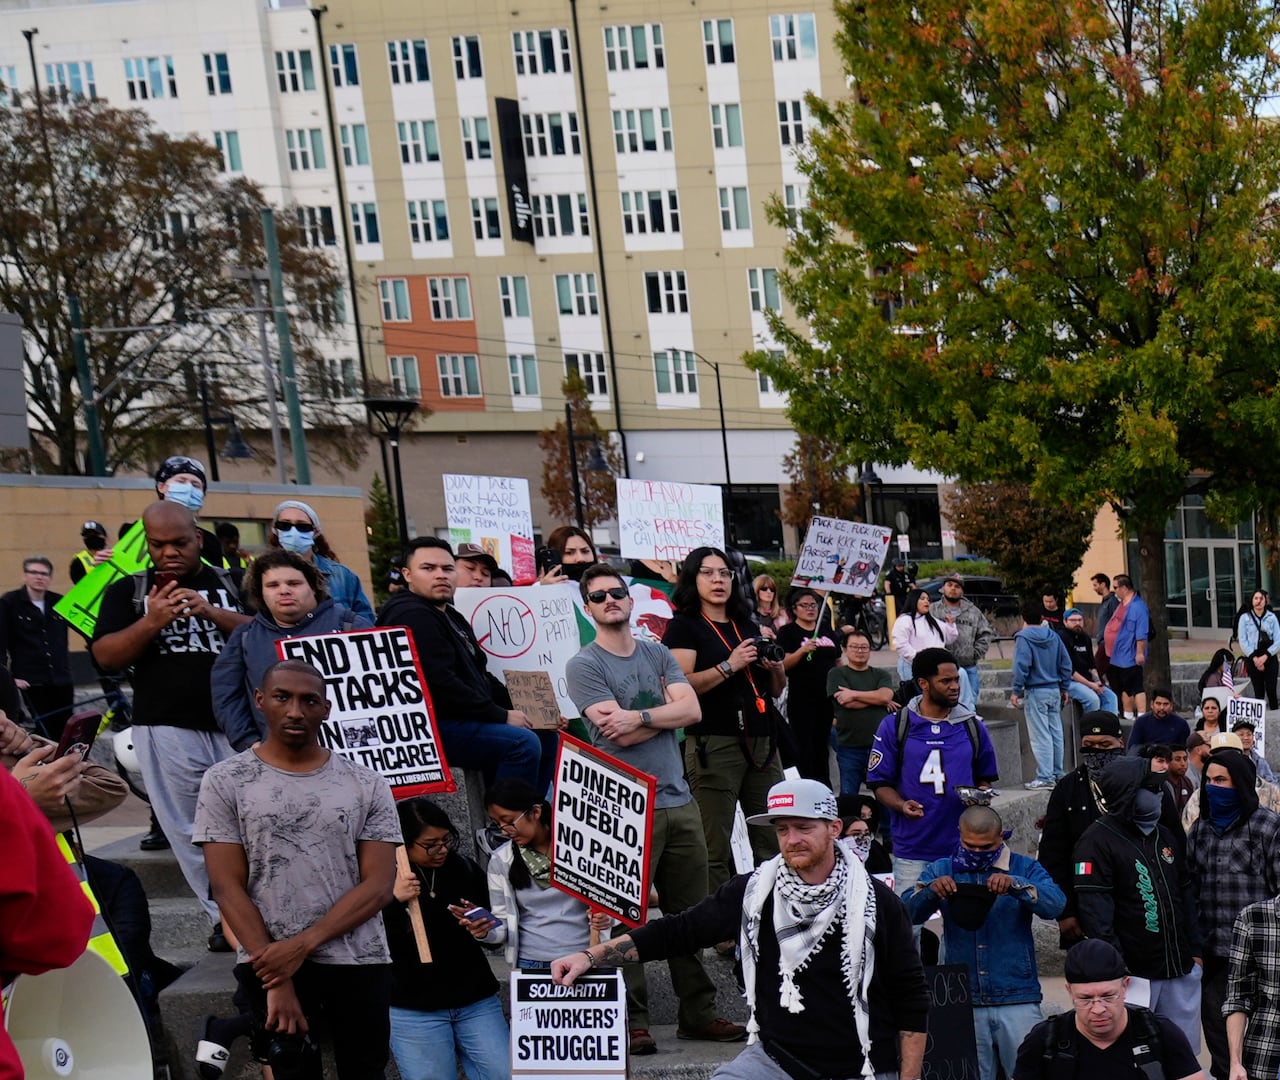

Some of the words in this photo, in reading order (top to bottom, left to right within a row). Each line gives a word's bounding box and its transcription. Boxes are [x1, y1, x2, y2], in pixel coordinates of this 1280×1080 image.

[446, 491, 473, 505] OUR
[477, 492, 519, 507] HARD
[654, 518, 706, 539] PADRES
[487, 606, 526, 648] NO
[350, 631, 414, 672] THE
[538, 651, 553, 666] IN
[1229, 699, 1263, 719] DEFEND
[376, 711, 432, 744] OUR
[403, 770, 442, 785] LIBERATION
[562, 758, 645, 816] ¡DINERO
[919, 749, 946, 795] 4
[581, 788, 608, 812] PARA
[612, 805, 624, 820] EL
[558, 789, 643, 857] PUEBLO,
[557, 821, 584, 853] NO
[590, 837, 641, 882] PARA
[555, 844, 573, 868] LA
[577, 855, 641, 900] GUERRA!
[528, 982, 607, 998] SOLIDARITY!
[535, 1007, 619, 1029] WORKERS'
[518, 1034, 620, 1062] STRUGGLE
